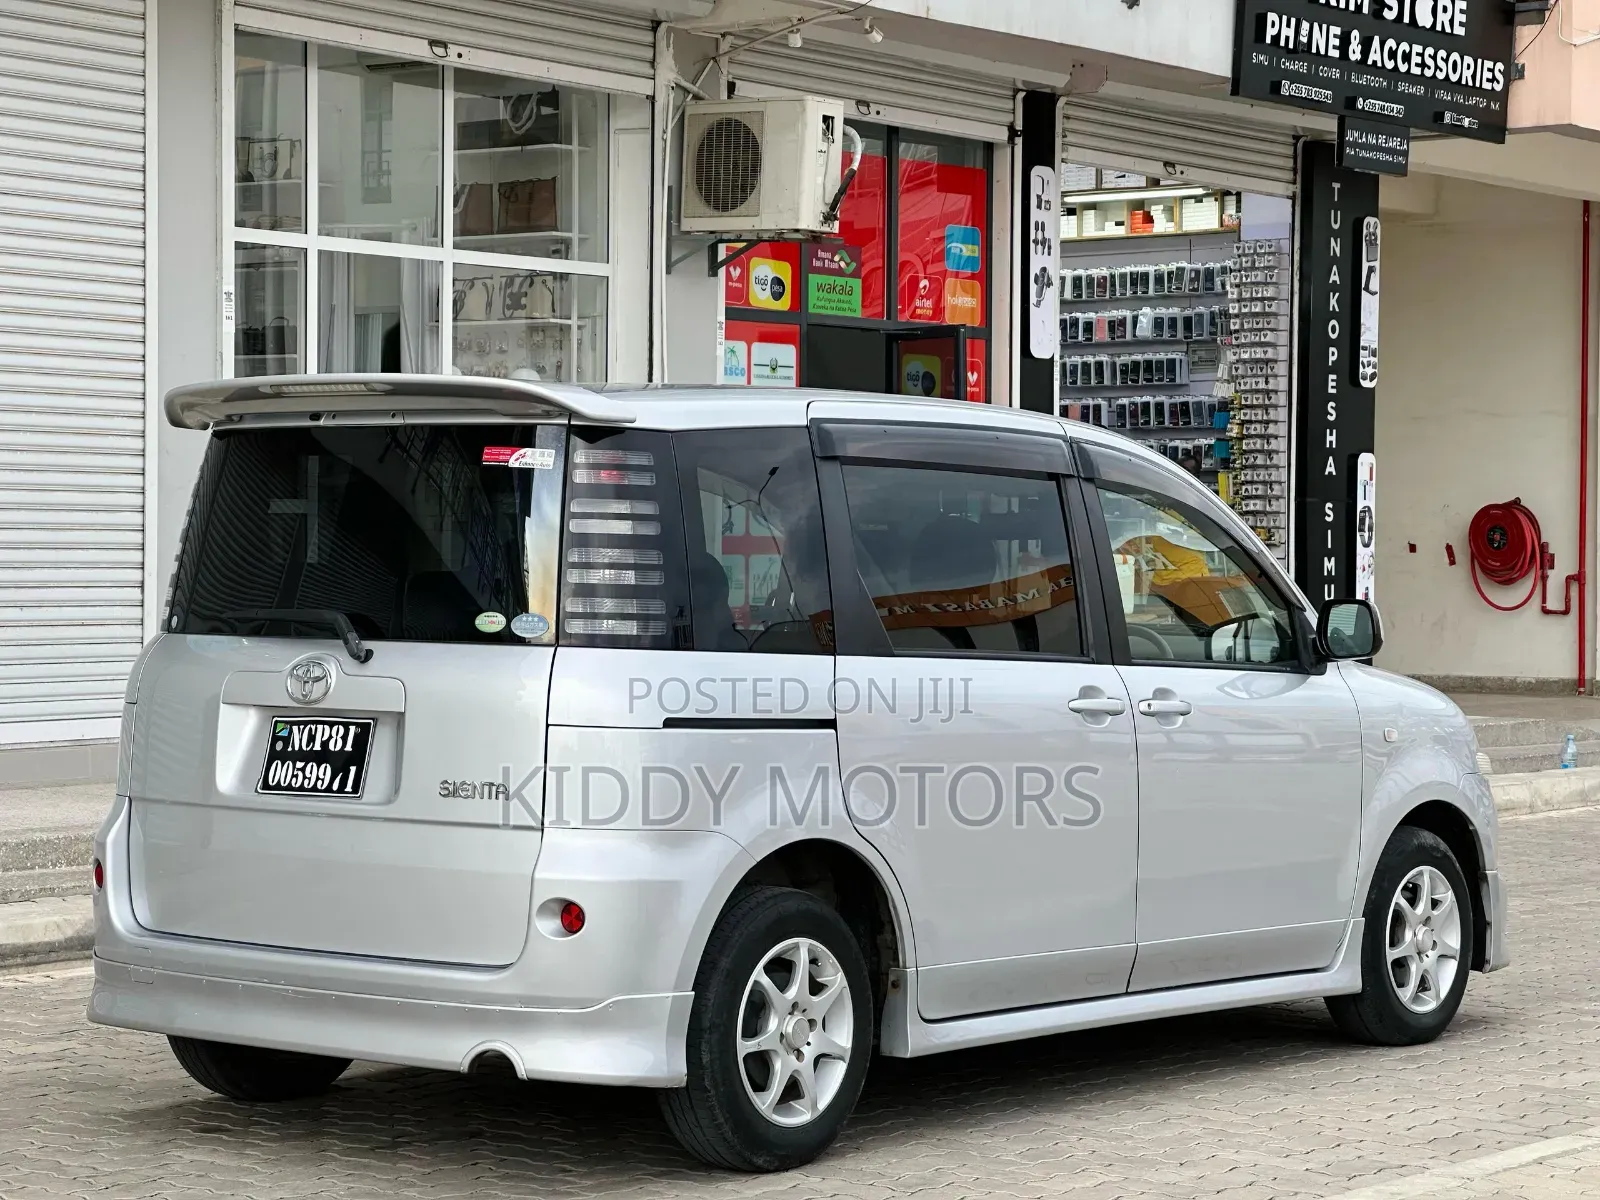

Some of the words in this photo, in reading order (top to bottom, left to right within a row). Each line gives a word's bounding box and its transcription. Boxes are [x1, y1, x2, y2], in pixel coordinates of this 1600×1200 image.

[1348, 28, 1361, 61] &
[1366, 35, 1505, 92] ACCESSORIES
[1252, 52, 1269, 66] SIMU
[1280, 58, 1308, 73] CHARGE
[1318, 65, 1340, 79] COVER
[1351, 72, 1387, 89] BLUETOOTH
[1397, 82, 1425, 96] SPEAKER
[1465, 96, 1487, 108] LAPTOP
[1345, 129, 1366, 143] JUMLA
[1367, 133, 1376, 145] NA
[1377, 134, 1408, 150] REJAREJA
[816, 279, 854, 296] wakala
[915, 296, 933, 308] airtel
[915, 308, 933, 317] money
[1324, 181, 1341, 475] TUNAKOPESHA
[1323, 502, 1335, 600] SIMU
[287, 724, 356, 752] NCP81
[438, 779, 510, 801] SIENTA
